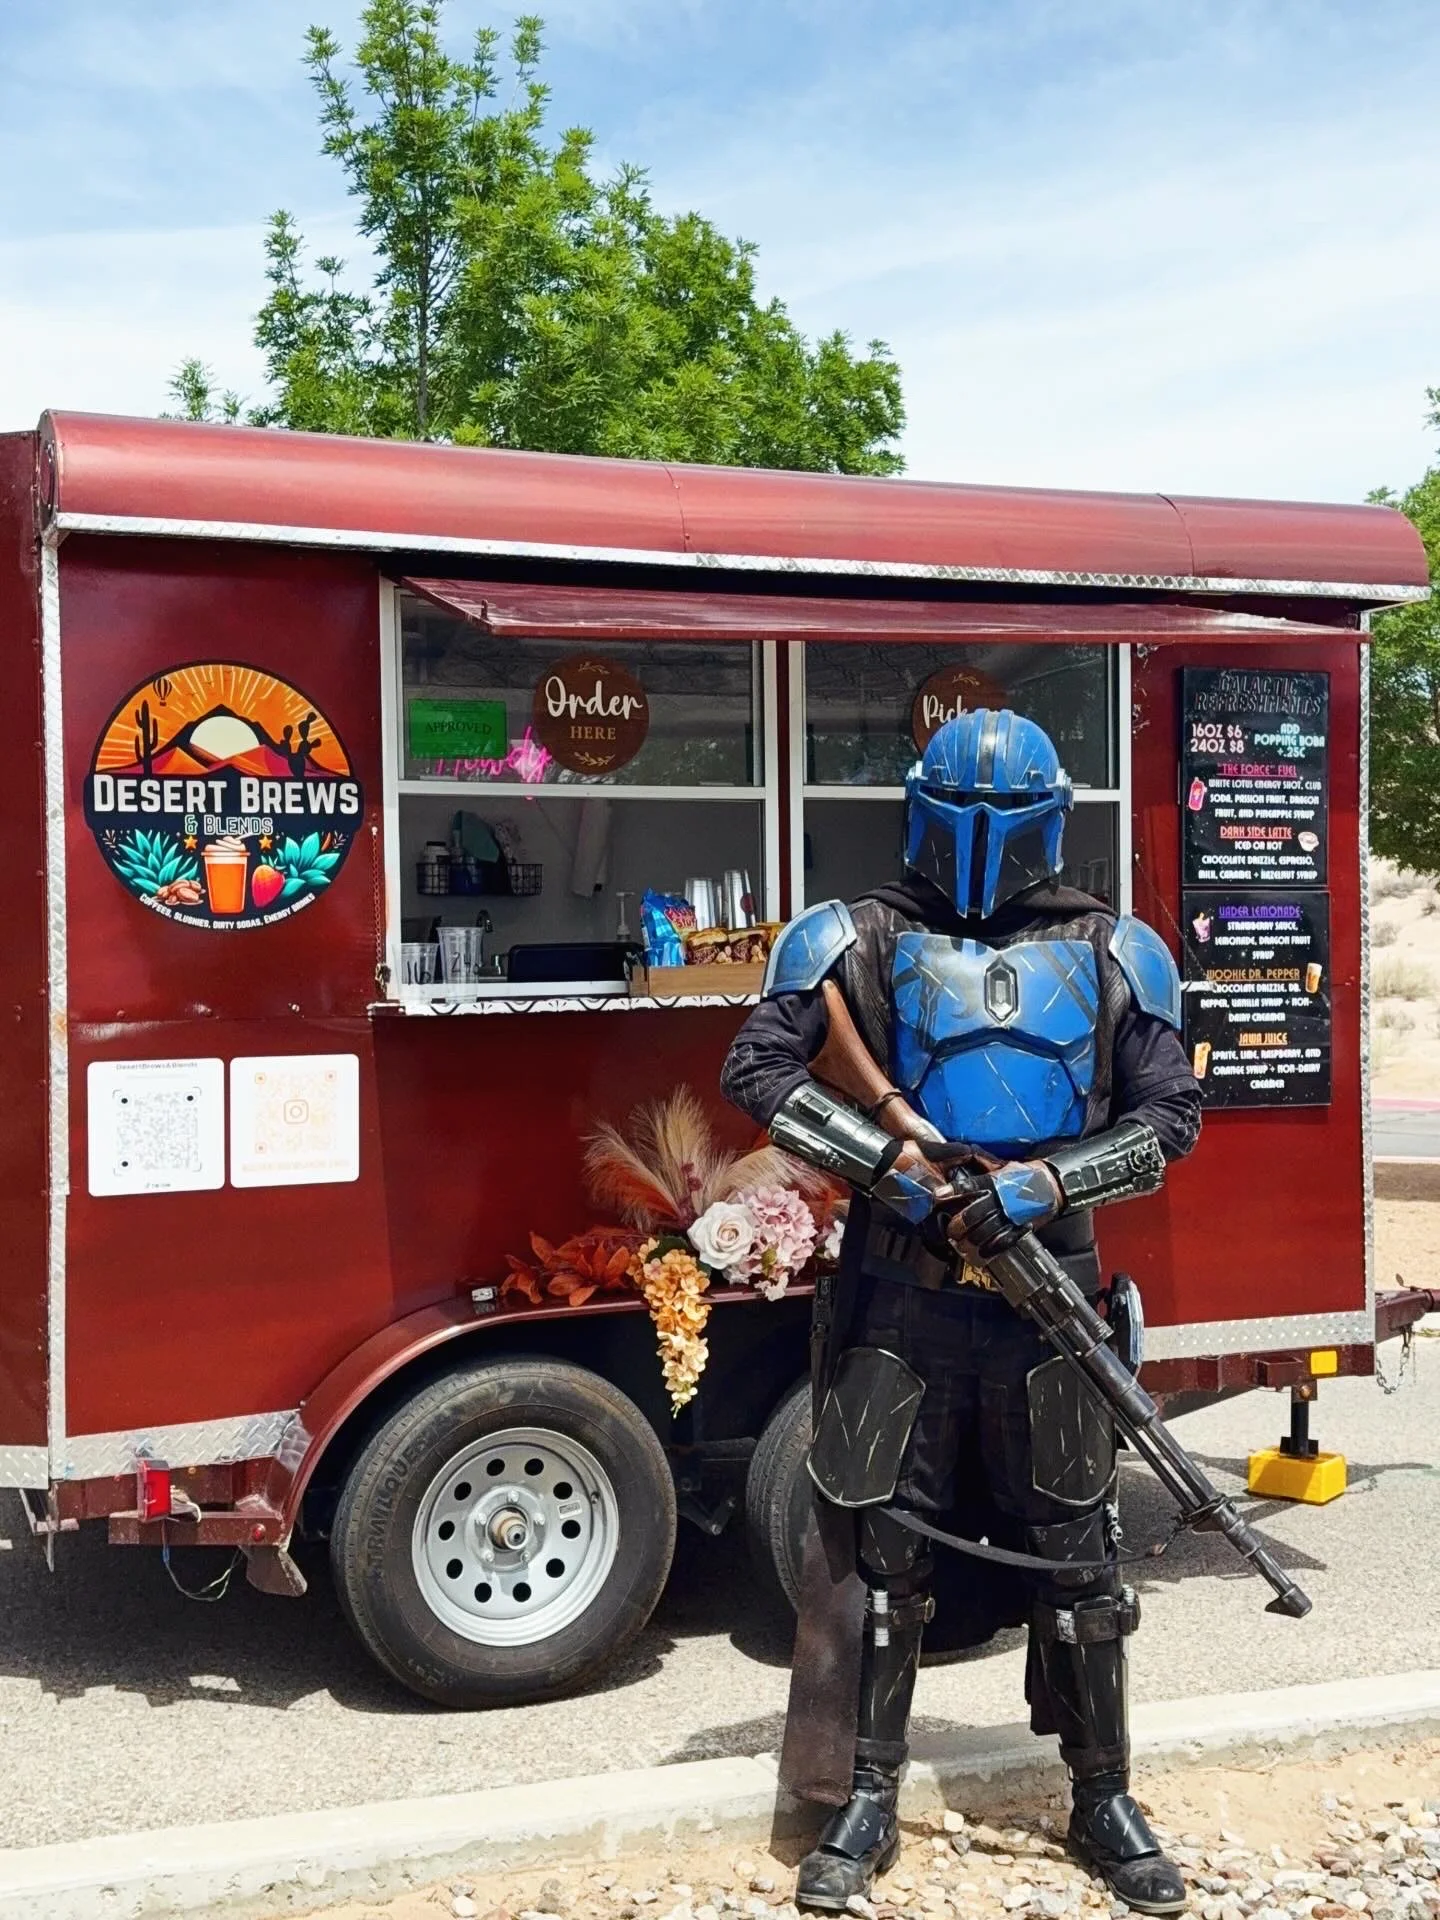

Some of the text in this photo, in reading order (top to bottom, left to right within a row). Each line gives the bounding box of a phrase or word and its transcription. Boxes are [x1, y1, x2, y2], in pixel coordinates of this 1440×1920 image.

[1221, 675, 1298, 695] GALACTIC
[545, 676, 643, 720] Order
[1195, 692, 1321, 714] REFRESHMENTS
[425, 720, 493, 736] APPROVED
[570, 725, 617, 741] HERE
[1227, 725, 1242, 738] $6
[1281, 723, 1300, 734] ADD
[1254, 734, 1325, 747] POPPING BOBA
[1230, 740, 1244, 753] $8
[1278, 765, 1296, 776] FUEL
[1209, 779, 1230, 787] WHITE
[1232, 780, 1253, 788] LOTUS
[1255, 780, 1281, 789] ENERGY
[1305, 781, 1321, 790] CLUB
[93, 774, 359, 815] DESERT BREWS
[1235, 794, 1264, 803] PASSION
[1266, 795, 1288, 804] FRUIT,
[1290, 796, 1319, 804] DRAGON
[1215, 809, 1315, 820] FRUIT, AND PINEAPPLE SYRUP
[184, 814, 274, 835] & BLENDS
[1221, 826, 1292, 839] DARK SIDE LATTE
[1235, 841, 1283, 850] ICED OR HOT
[1202, 855, 1245, 865] CHOCOLATE
[1220, 870, 1251, 879] CARAMEL
[1261, 869, 1295, 879] HAZELNUT
[1296, 870, 1318, 879] SYRUP
[1251, 906, 1300, 918] LEMONADE
[213, 921, 234, 930] DIRTY
[1227, 922, 1274, 930] STRAWBERRY
[1259, 936, 1290, 945] DRAGON
[1291, 936, 1311, 944] FRUIT
[1252, 951, 1275, 960] SYRUP
[406, 960, 432, 986] 16
[1206, 968, 1300, 980] WOOKIE DR. PEPPER
[1289, 983, 1301, 992] DR.
[1261, 998, 1283, 1007] SYRUP
[1292, 998, 1313, 1006] NON-
[1229, 1013, 1285, 1022] DAIRY CREAMER
[1239, 1033, 1288, 1045] JAWA JUICE
[1305, 1048, 1321, 1057] AND
[1213, 1066, 1244, 1075] ORANGE
[1246, 1065, 1268, 1074] SYRUP
[1277, 1063, 1320, 1073] NON-DAIRY
[1250, 1079, 1285, 1089] CREAMER
